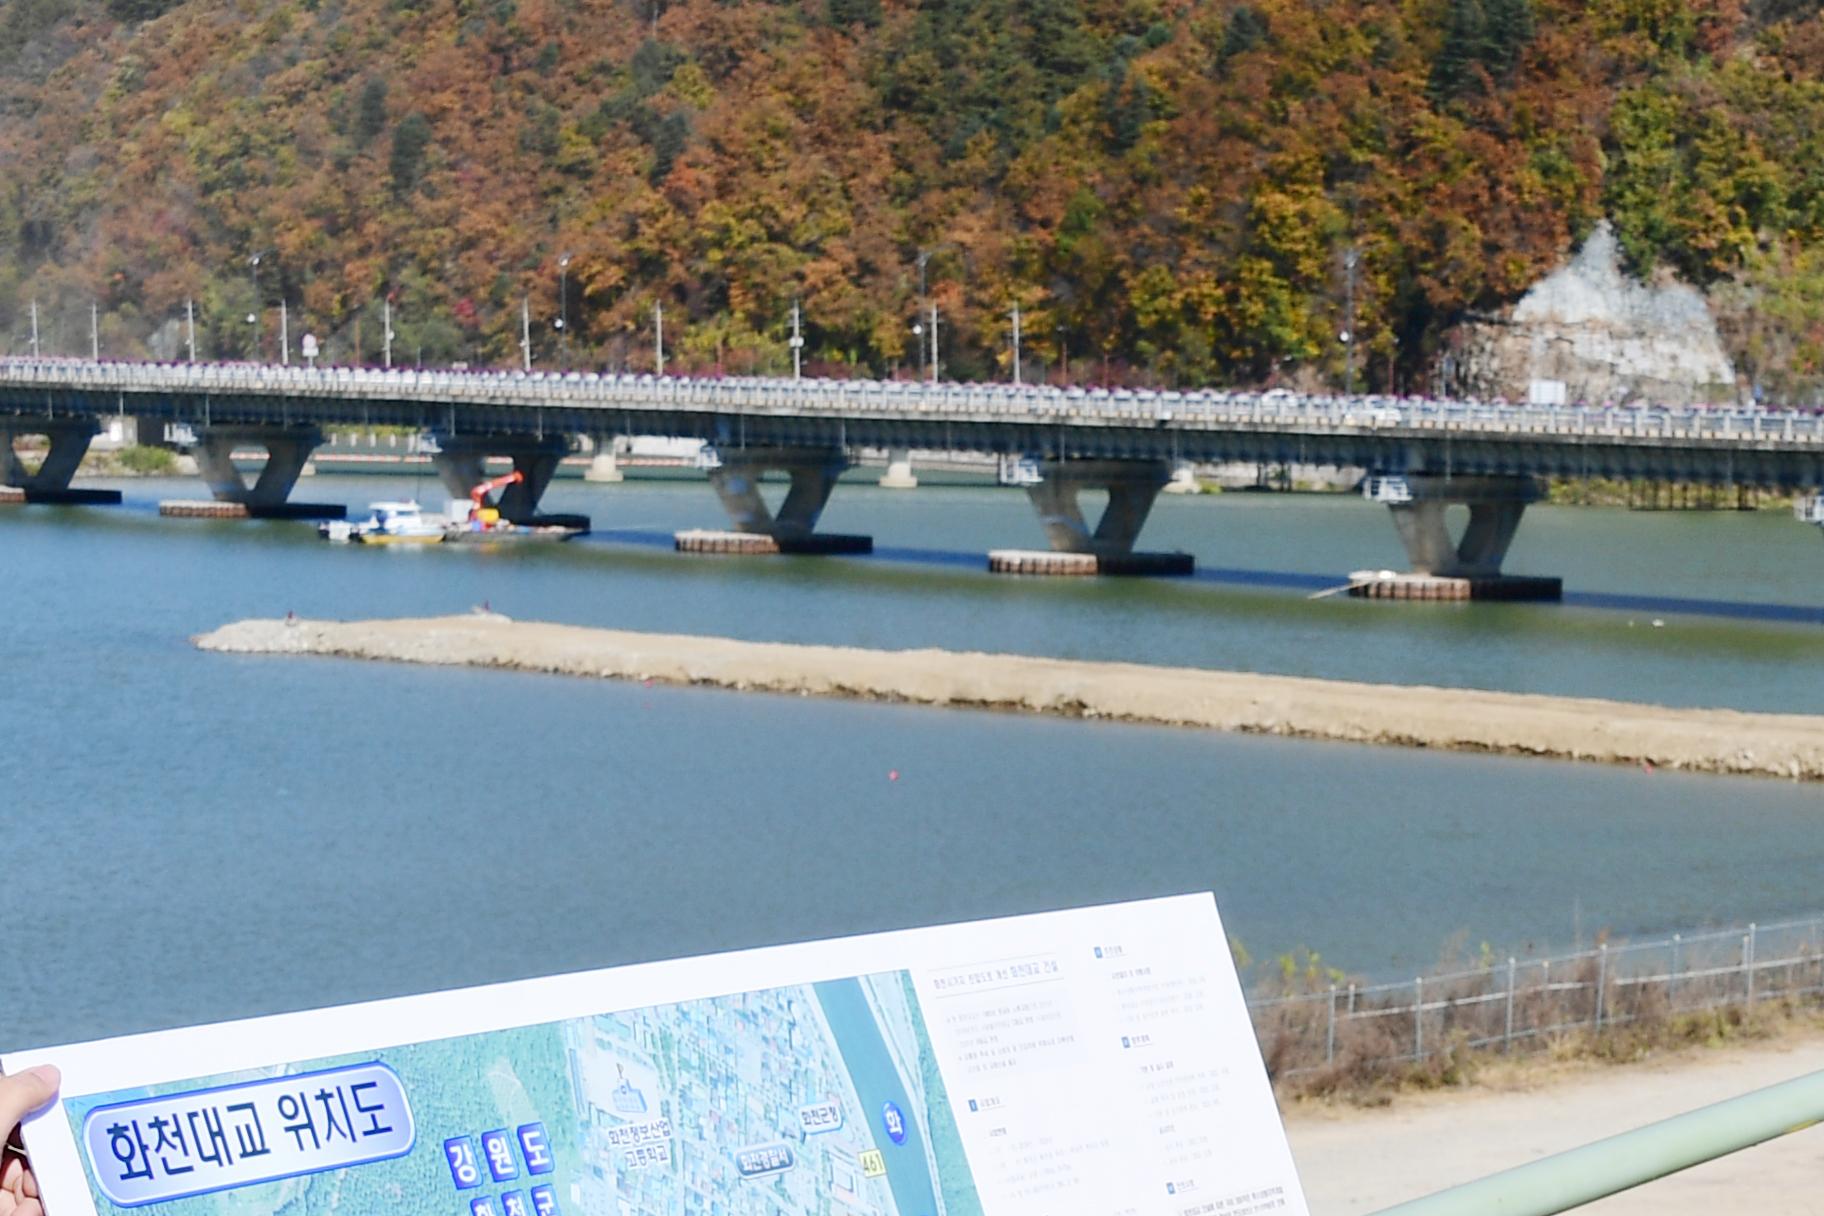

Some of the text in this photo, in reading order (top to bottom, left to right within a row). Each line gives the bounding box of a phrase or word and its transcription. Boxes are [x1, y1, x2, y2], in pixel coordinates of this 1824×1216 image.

[801, 1106, 838, 1126] 화천군청
[884, 1110, 904, 1135] 화
[107, 1081, 393, 1181] 화천대교 위치도
[607, 1120, 670, 1145] 화천정보산업
[447, 1130, 550, 1182] 강원도
[625, 1145, 668, 1166] 고등학교
[740, 1148, 789, 1171] 화천경찰서
[860, 1154, 883, 1173] 461
